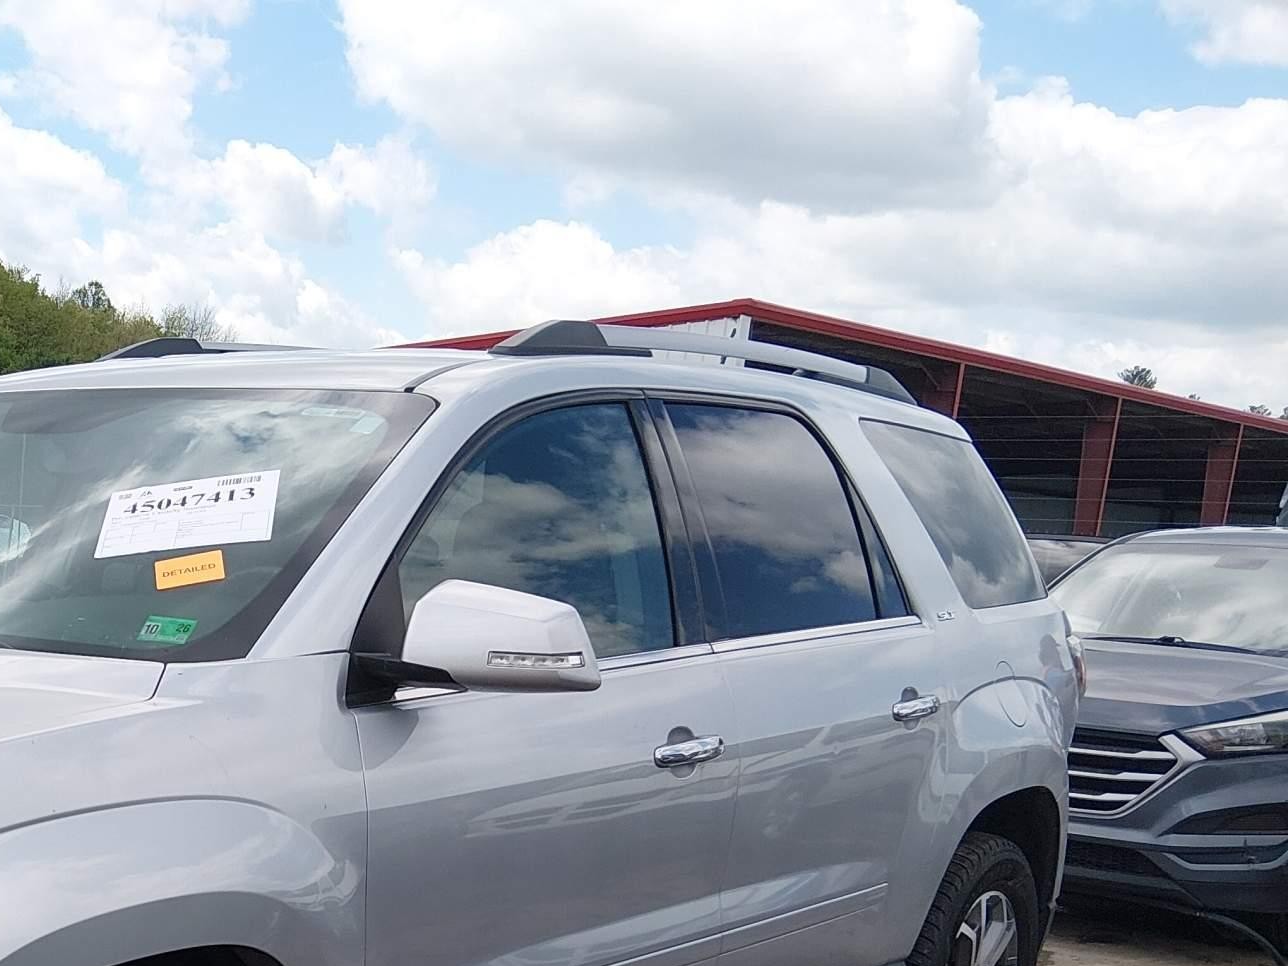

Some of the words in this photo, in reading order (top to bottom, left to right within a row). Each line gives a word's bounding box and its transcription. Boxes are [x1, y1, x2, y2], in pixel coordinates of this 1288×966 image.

[123, 487, 256, 514] 45047413
[162, 563, 216, 577] DETAILED
[144, 623, 160, 635] 10
[175, 623, 192, 633] 26
